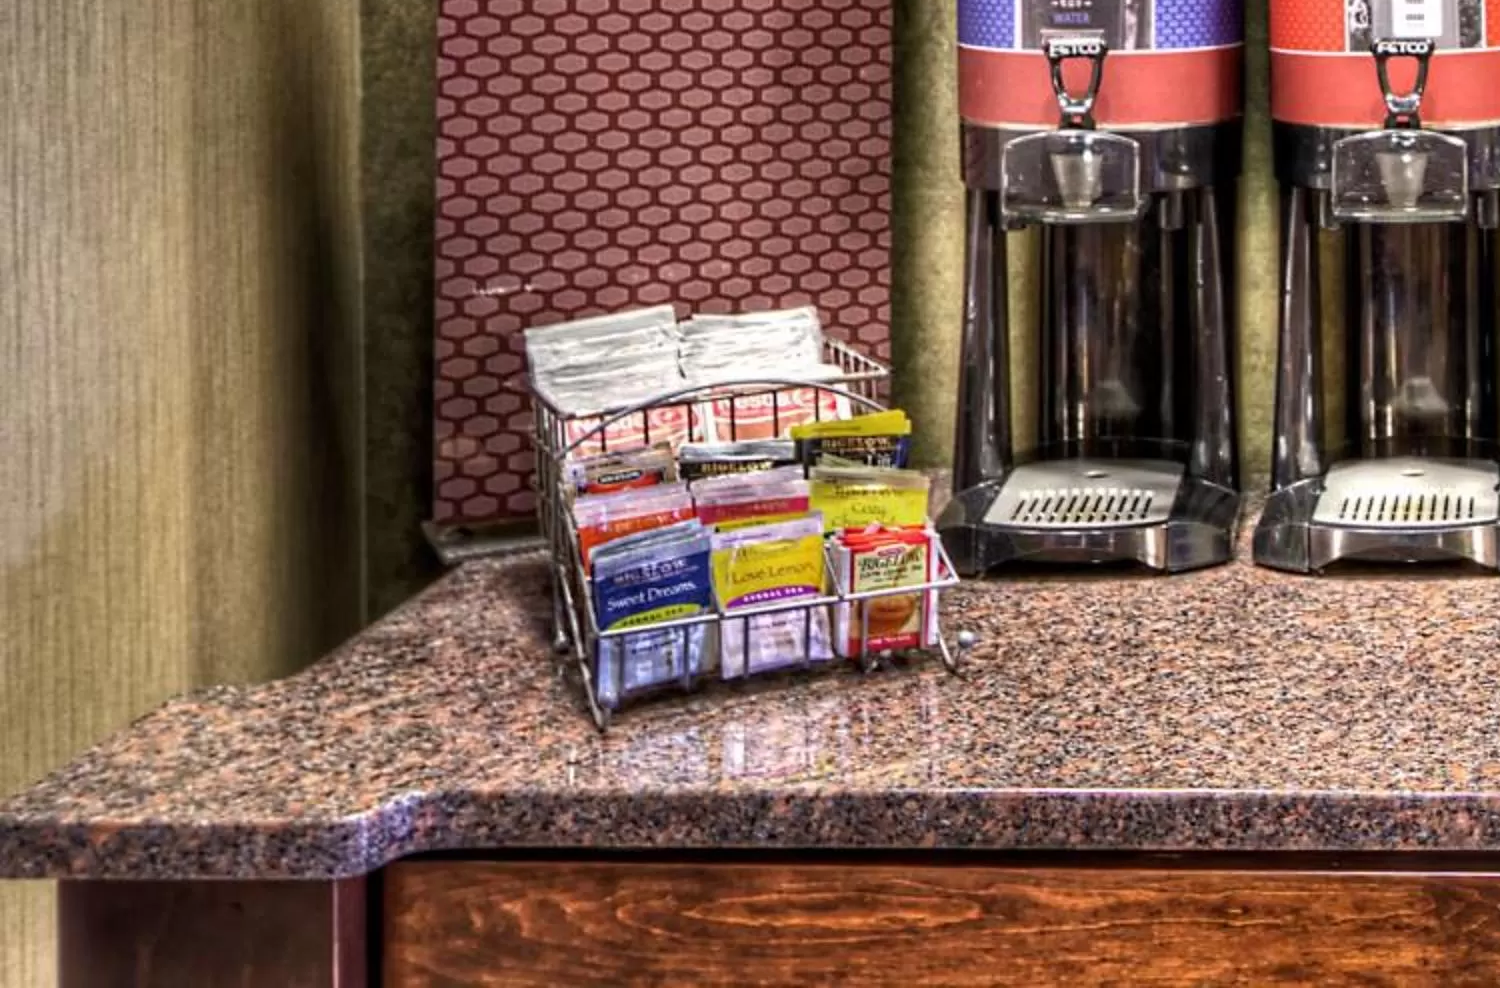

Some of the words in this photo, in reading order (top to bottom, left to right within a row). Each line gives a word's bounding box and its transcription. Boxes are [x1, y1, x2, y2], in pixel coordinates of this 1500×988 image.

[1049, 41, 1101, 57] FETCO
[1376, 42, 1429, 53] FETCO
[768, 561, 816, 579] Lemon
[607, 592, 645, 611] Sweet
[647, 581, 697, 602] Dreams
